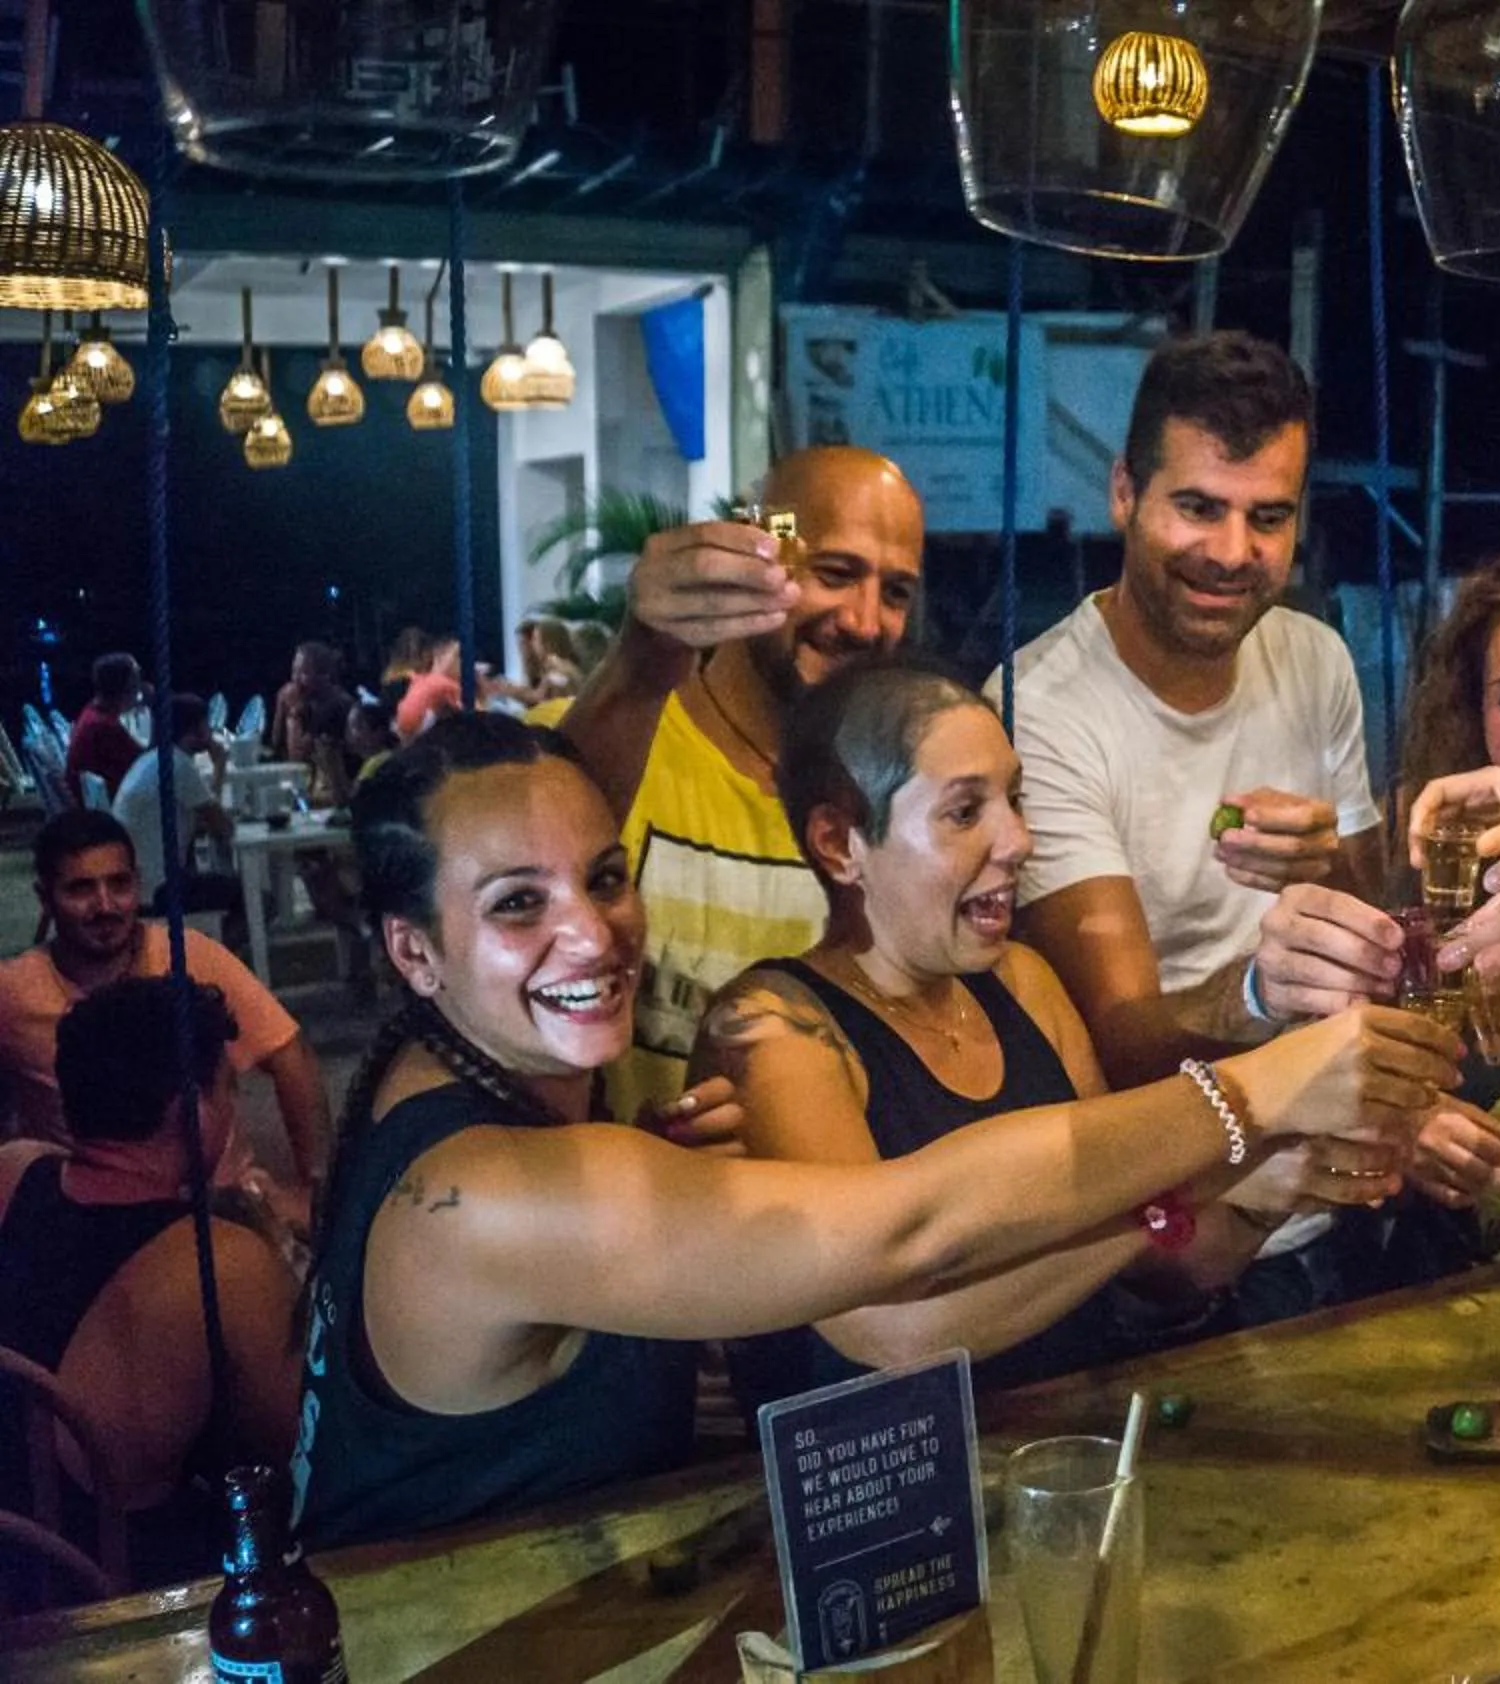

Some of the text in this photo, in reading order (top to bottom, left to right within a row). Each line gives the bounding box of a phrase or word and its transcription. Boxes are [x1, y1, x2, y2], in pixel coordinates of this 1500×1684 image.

[875, 382, 1004, 427] ATHEN
[798, 1414, 935, 1473] DID YOU HAVE FUN?
[801, 1437, 939, 1496] WE WOULD LOVE TO
[804, 1461, 935, 1518] HEAR ABOUT YOUR
[875, 1554, 951, 1595] SPREAD THE
[877, 1572, 956, 1613] HAPPINESS
